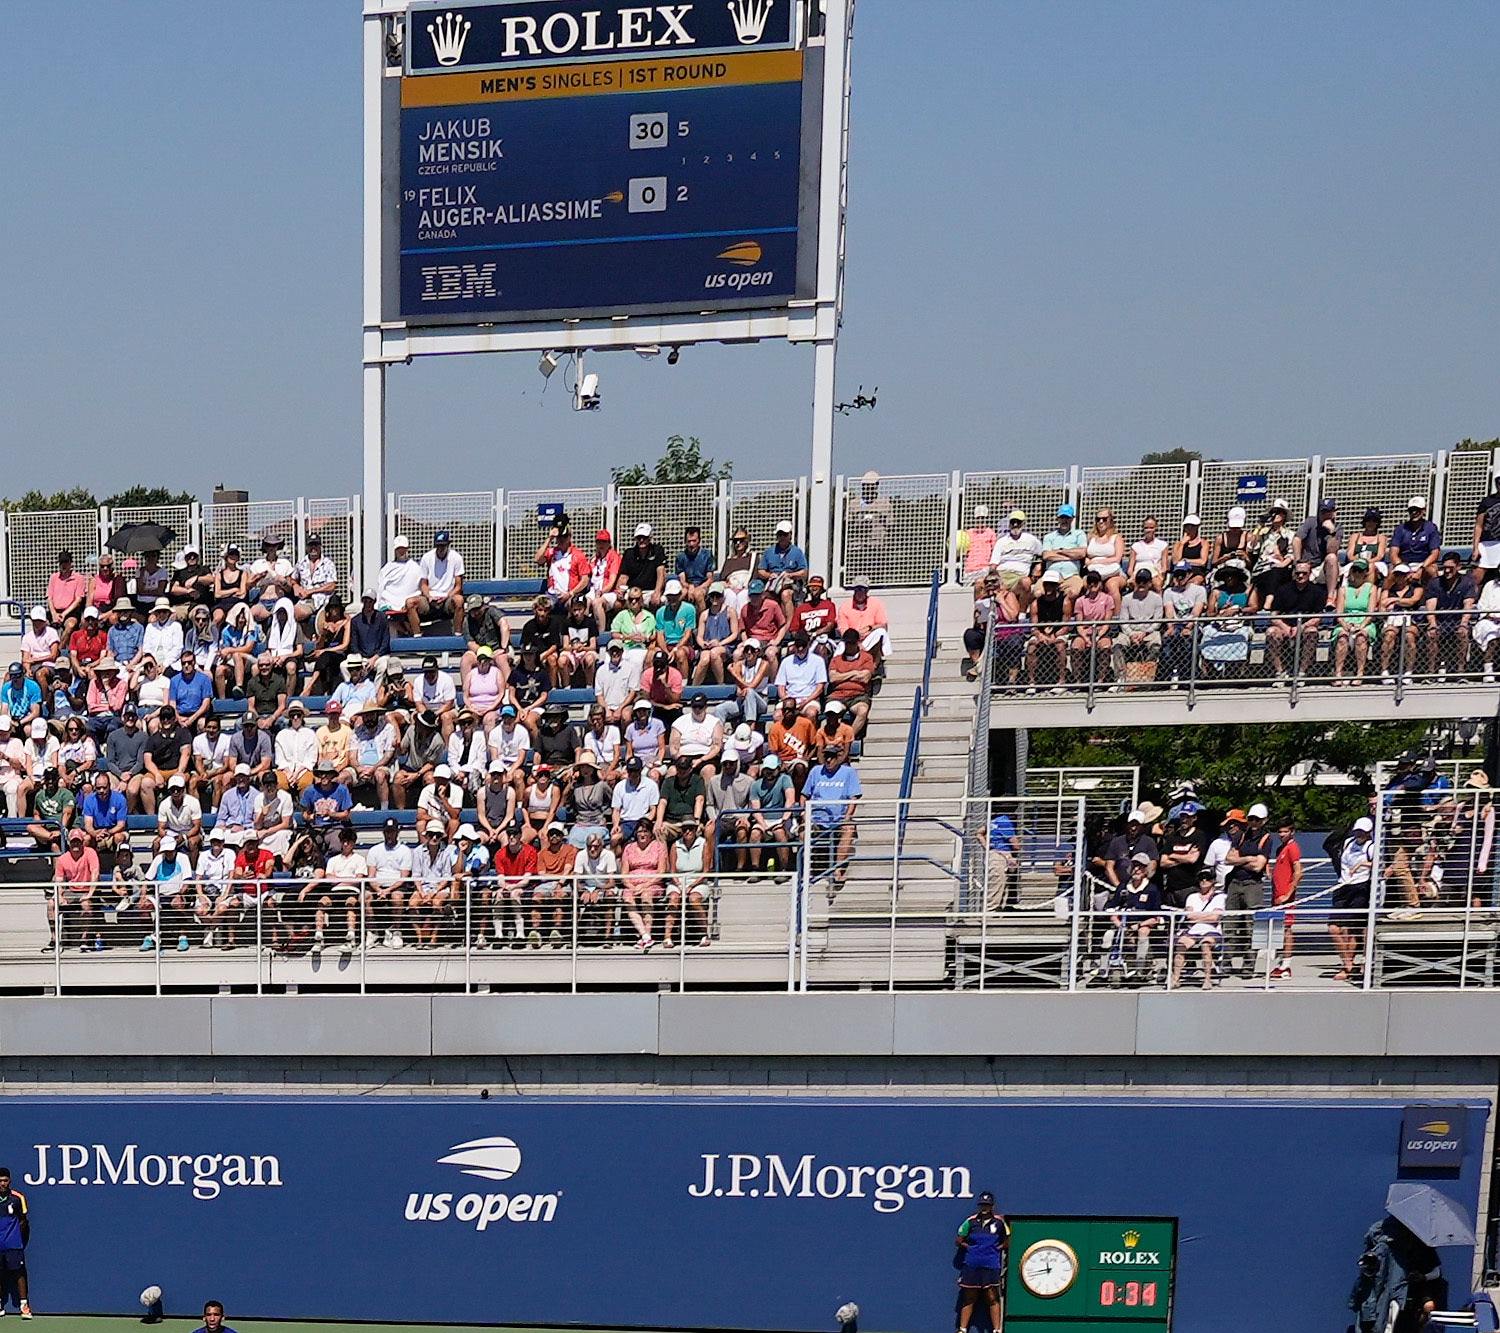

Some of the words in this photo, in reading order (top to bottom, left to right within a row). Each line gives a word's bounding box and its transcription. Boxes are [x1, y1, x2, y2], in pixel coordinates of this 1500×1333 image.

[501, 4, 696, 56] ROLEX
[480, 75, 536, 94] MEN'S
[542, 71, 613, 91] SINGLES
[628, 65, 658, 84] 1ST
[663, 62, 727, 82] ROUND
[418, 118, 491, 141] JAKUB
[635, 121, 664, 140] 30
[677, 122, 689, 138] 5
[418, 140, 504, 162] MENSIK
[418, 164, 448, 175] CZECH
[450, 161, 497, 173] REPUBLIC
[404, 190, 416, 201] 19
[418, 186, 477, 208] FELIX
[641, 186, 656, 205] 0
[677, 186, 689, 202] 2
[418, 200, 602, 230] AUGER-ALIASSIME
[418, 229, 457, 240] CANADA
[421, 263, 499, 301] IBM
[704, 272, 728, 290] us
[729, 270, 773, 292] open
[1407, 1139, 1424, 1151] us
[1426, 1138, 1458, 1153] open
[24, 1144, 283, 1200] J.P.Morgan
[688, 1154, 974, 1213] J.P.Morgan
[405, 1192, 451, 1222] us
[456, 1191, 559, 1231] open
[1100, 1252, 1160, 1265] ROLEX
[1100, 1280, 1157, 1307] 0:34
